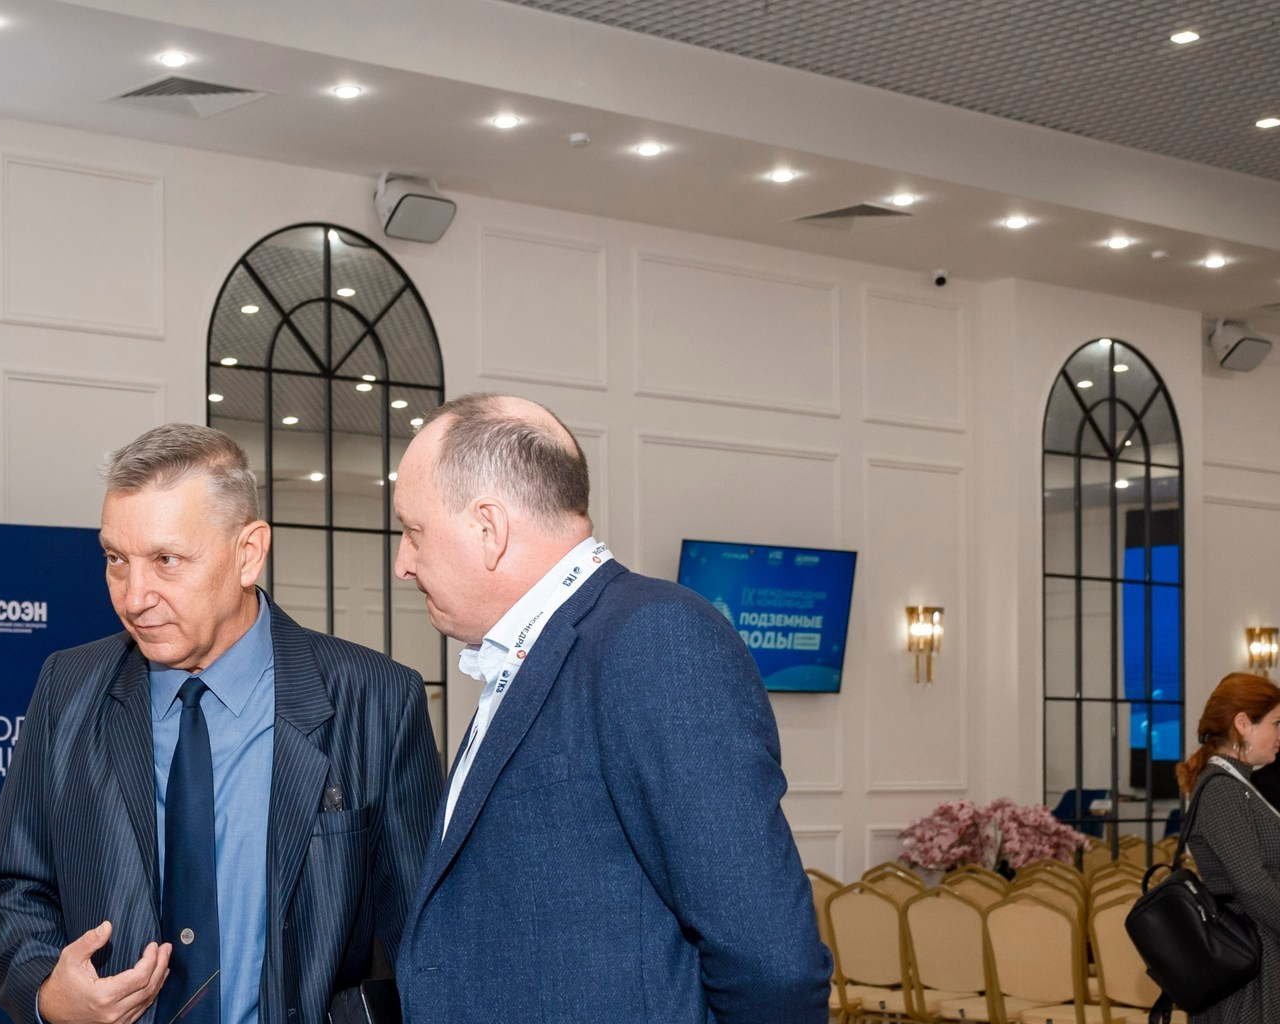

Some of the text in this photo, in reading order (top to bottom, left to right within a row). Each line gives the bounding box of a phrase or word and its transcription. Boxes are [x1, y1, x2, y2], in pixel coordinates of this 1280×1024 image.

[562, 573, 577, 587] ГКЗ
[740, 612, 823, 628] ПОДЗЕМНЫЕ
[514, 611, 544, 648] РОСНЕДРА
